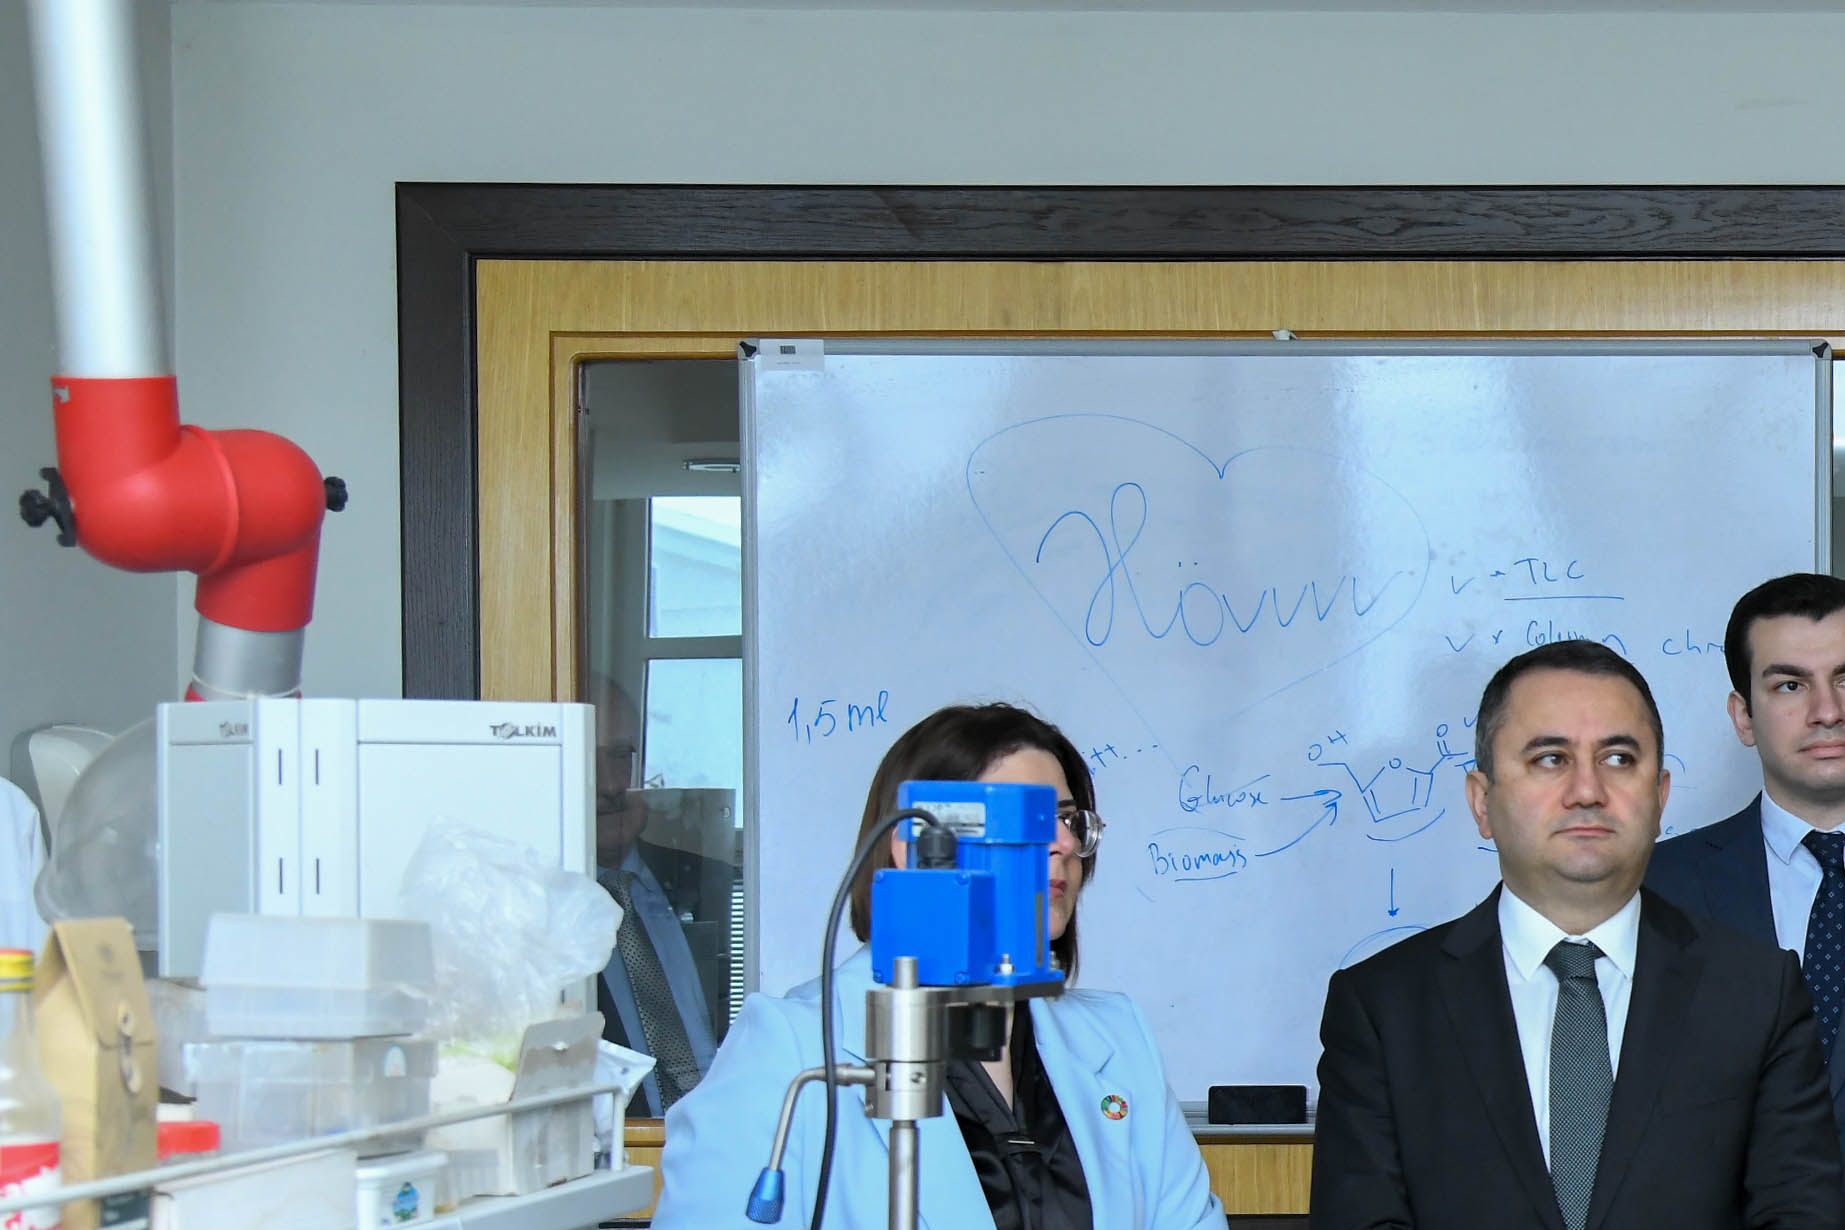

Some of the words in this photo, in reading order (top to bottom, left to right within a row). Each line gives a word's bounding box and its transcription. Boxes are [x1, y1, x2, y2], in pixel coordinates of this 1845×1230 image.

[1513, 558, 1585, 585] TLC
[787, 697, 837, 745] 1,5
[1148, 842, 1248, 876] Biomass
